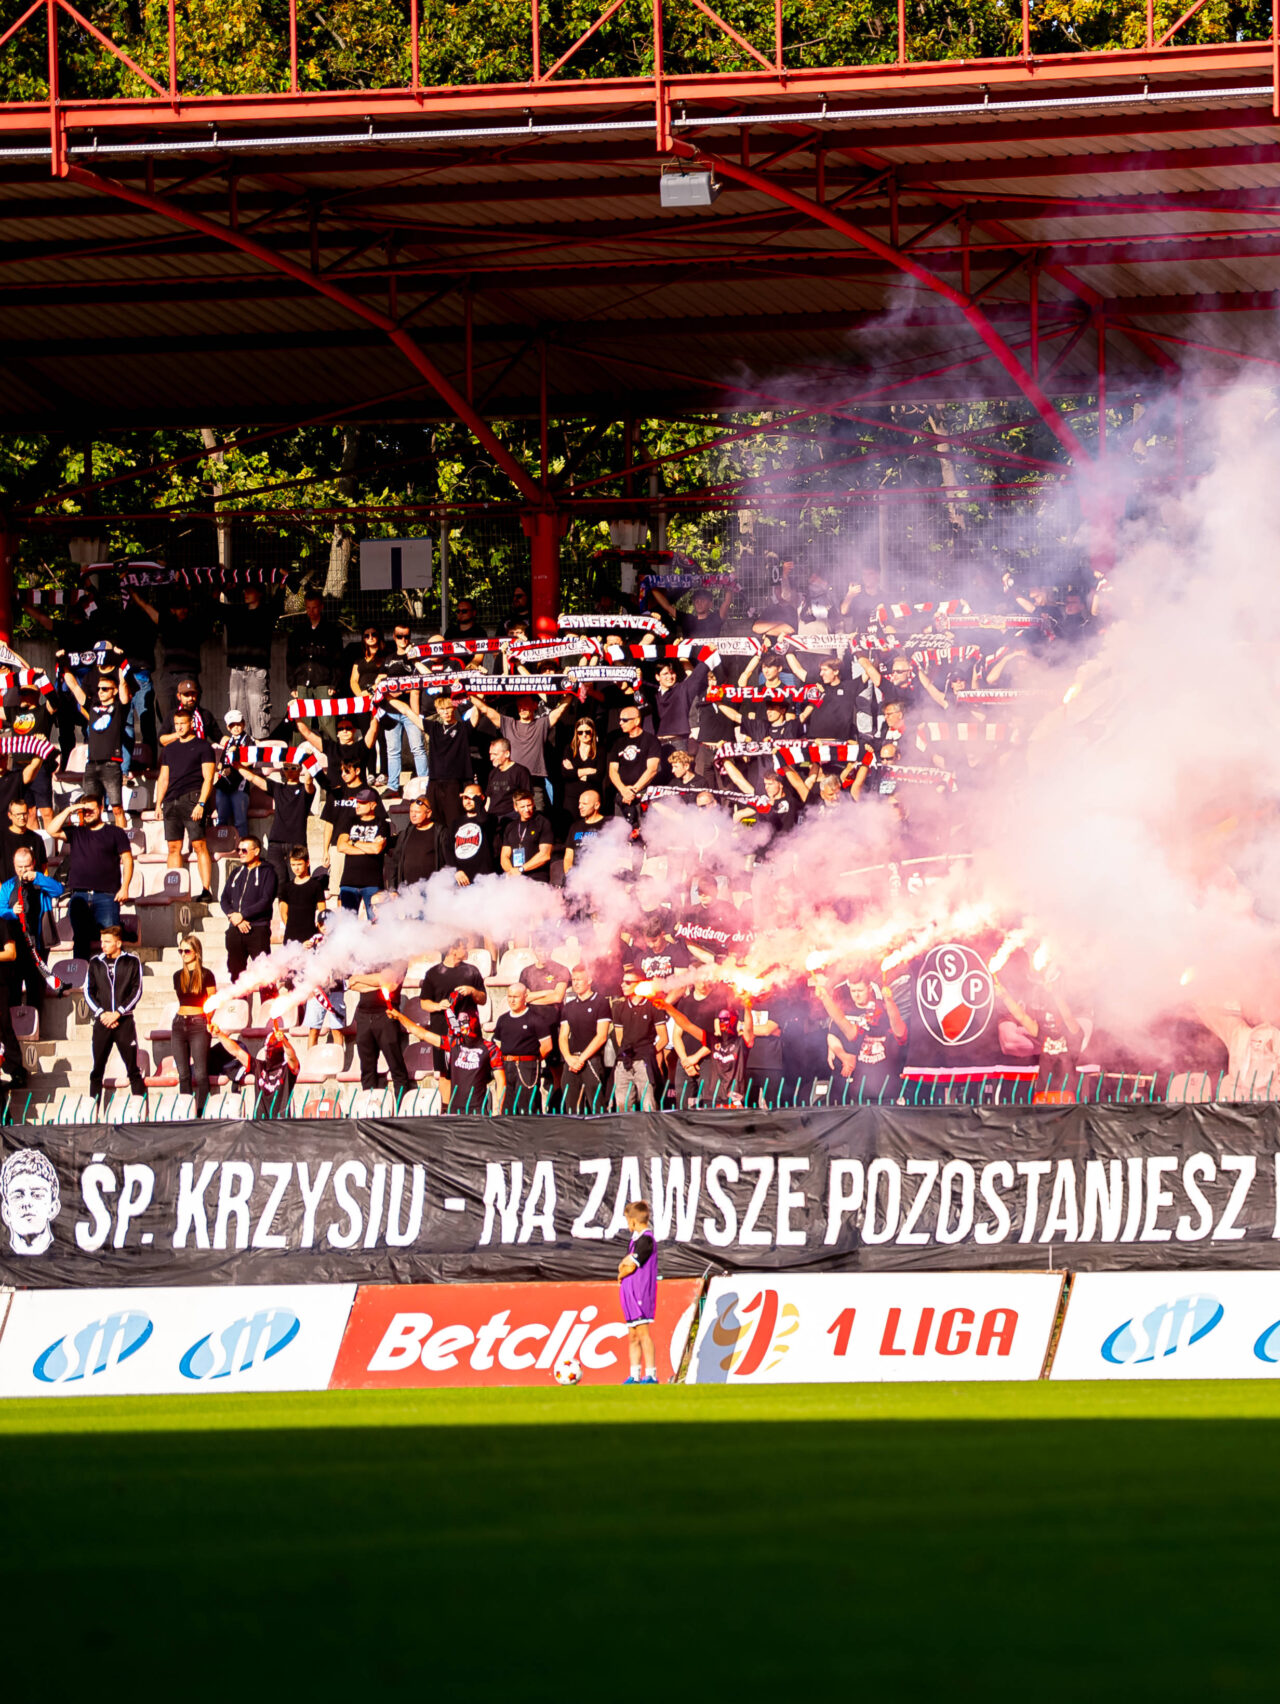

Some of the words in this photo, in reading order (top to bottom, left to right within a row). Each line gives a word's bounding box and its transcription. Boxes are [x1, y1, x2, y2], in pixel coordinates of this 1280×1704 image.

[464, 684, 501, 692] POLONIA
[503, 684, 557, 692] WARSZAWA
[726, 685, 804, 699] BIELANY
[76, 1153, 154, 1252] ŚP.
[172, 1160, 427, 1250] KRZYSIU
[478, 1160, 557, 1246] NA
[571, 1156, 810, 1247] ZAWSZE
[824, 1152, 1257, 1246] POZOSTANIESZ
[367, 1305, 628, 1373] Betclic
[827, 1308, 856, 1356] 1
[880, 1307, 1019, 1356] LIGA
